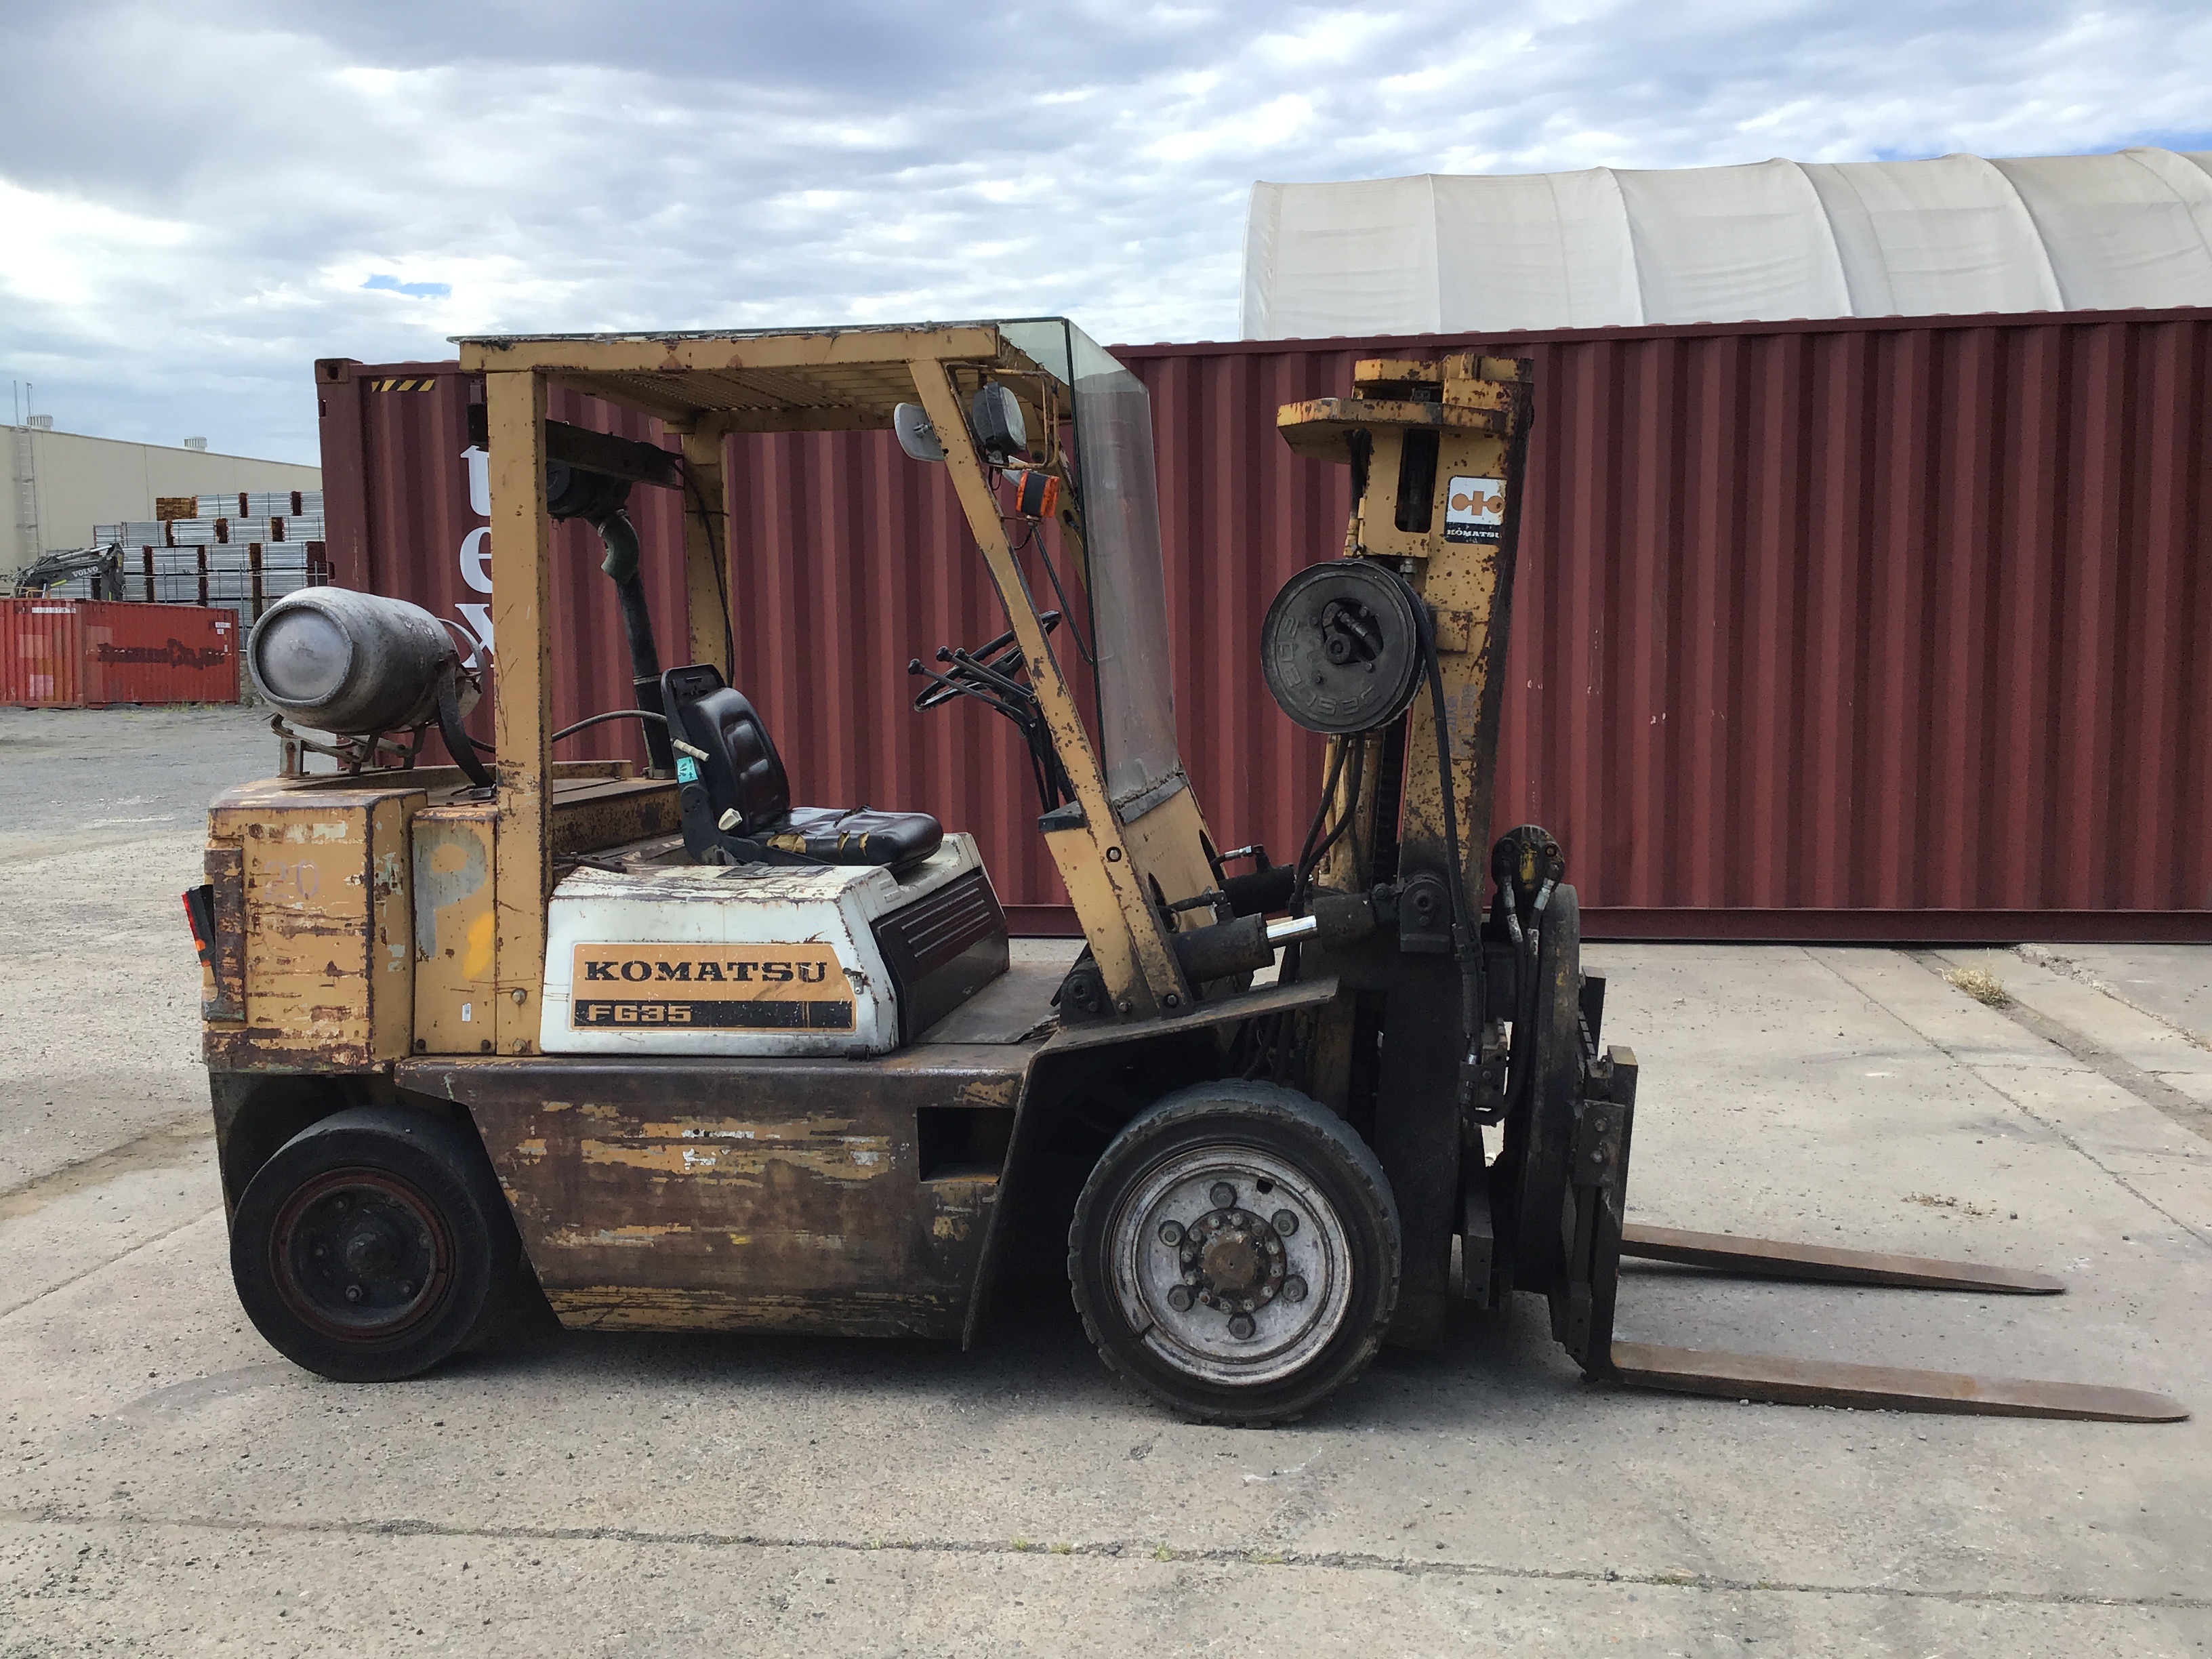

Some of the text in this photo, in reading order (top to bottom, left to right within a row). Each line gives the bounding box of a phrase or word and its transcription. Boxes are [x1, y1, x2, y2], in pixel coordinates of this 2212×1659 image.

[72, 566, 98, 577] VOLVO
[584, 960, 827, 983] KOMATSU
[588, 1004, 692, 1022] FG35
